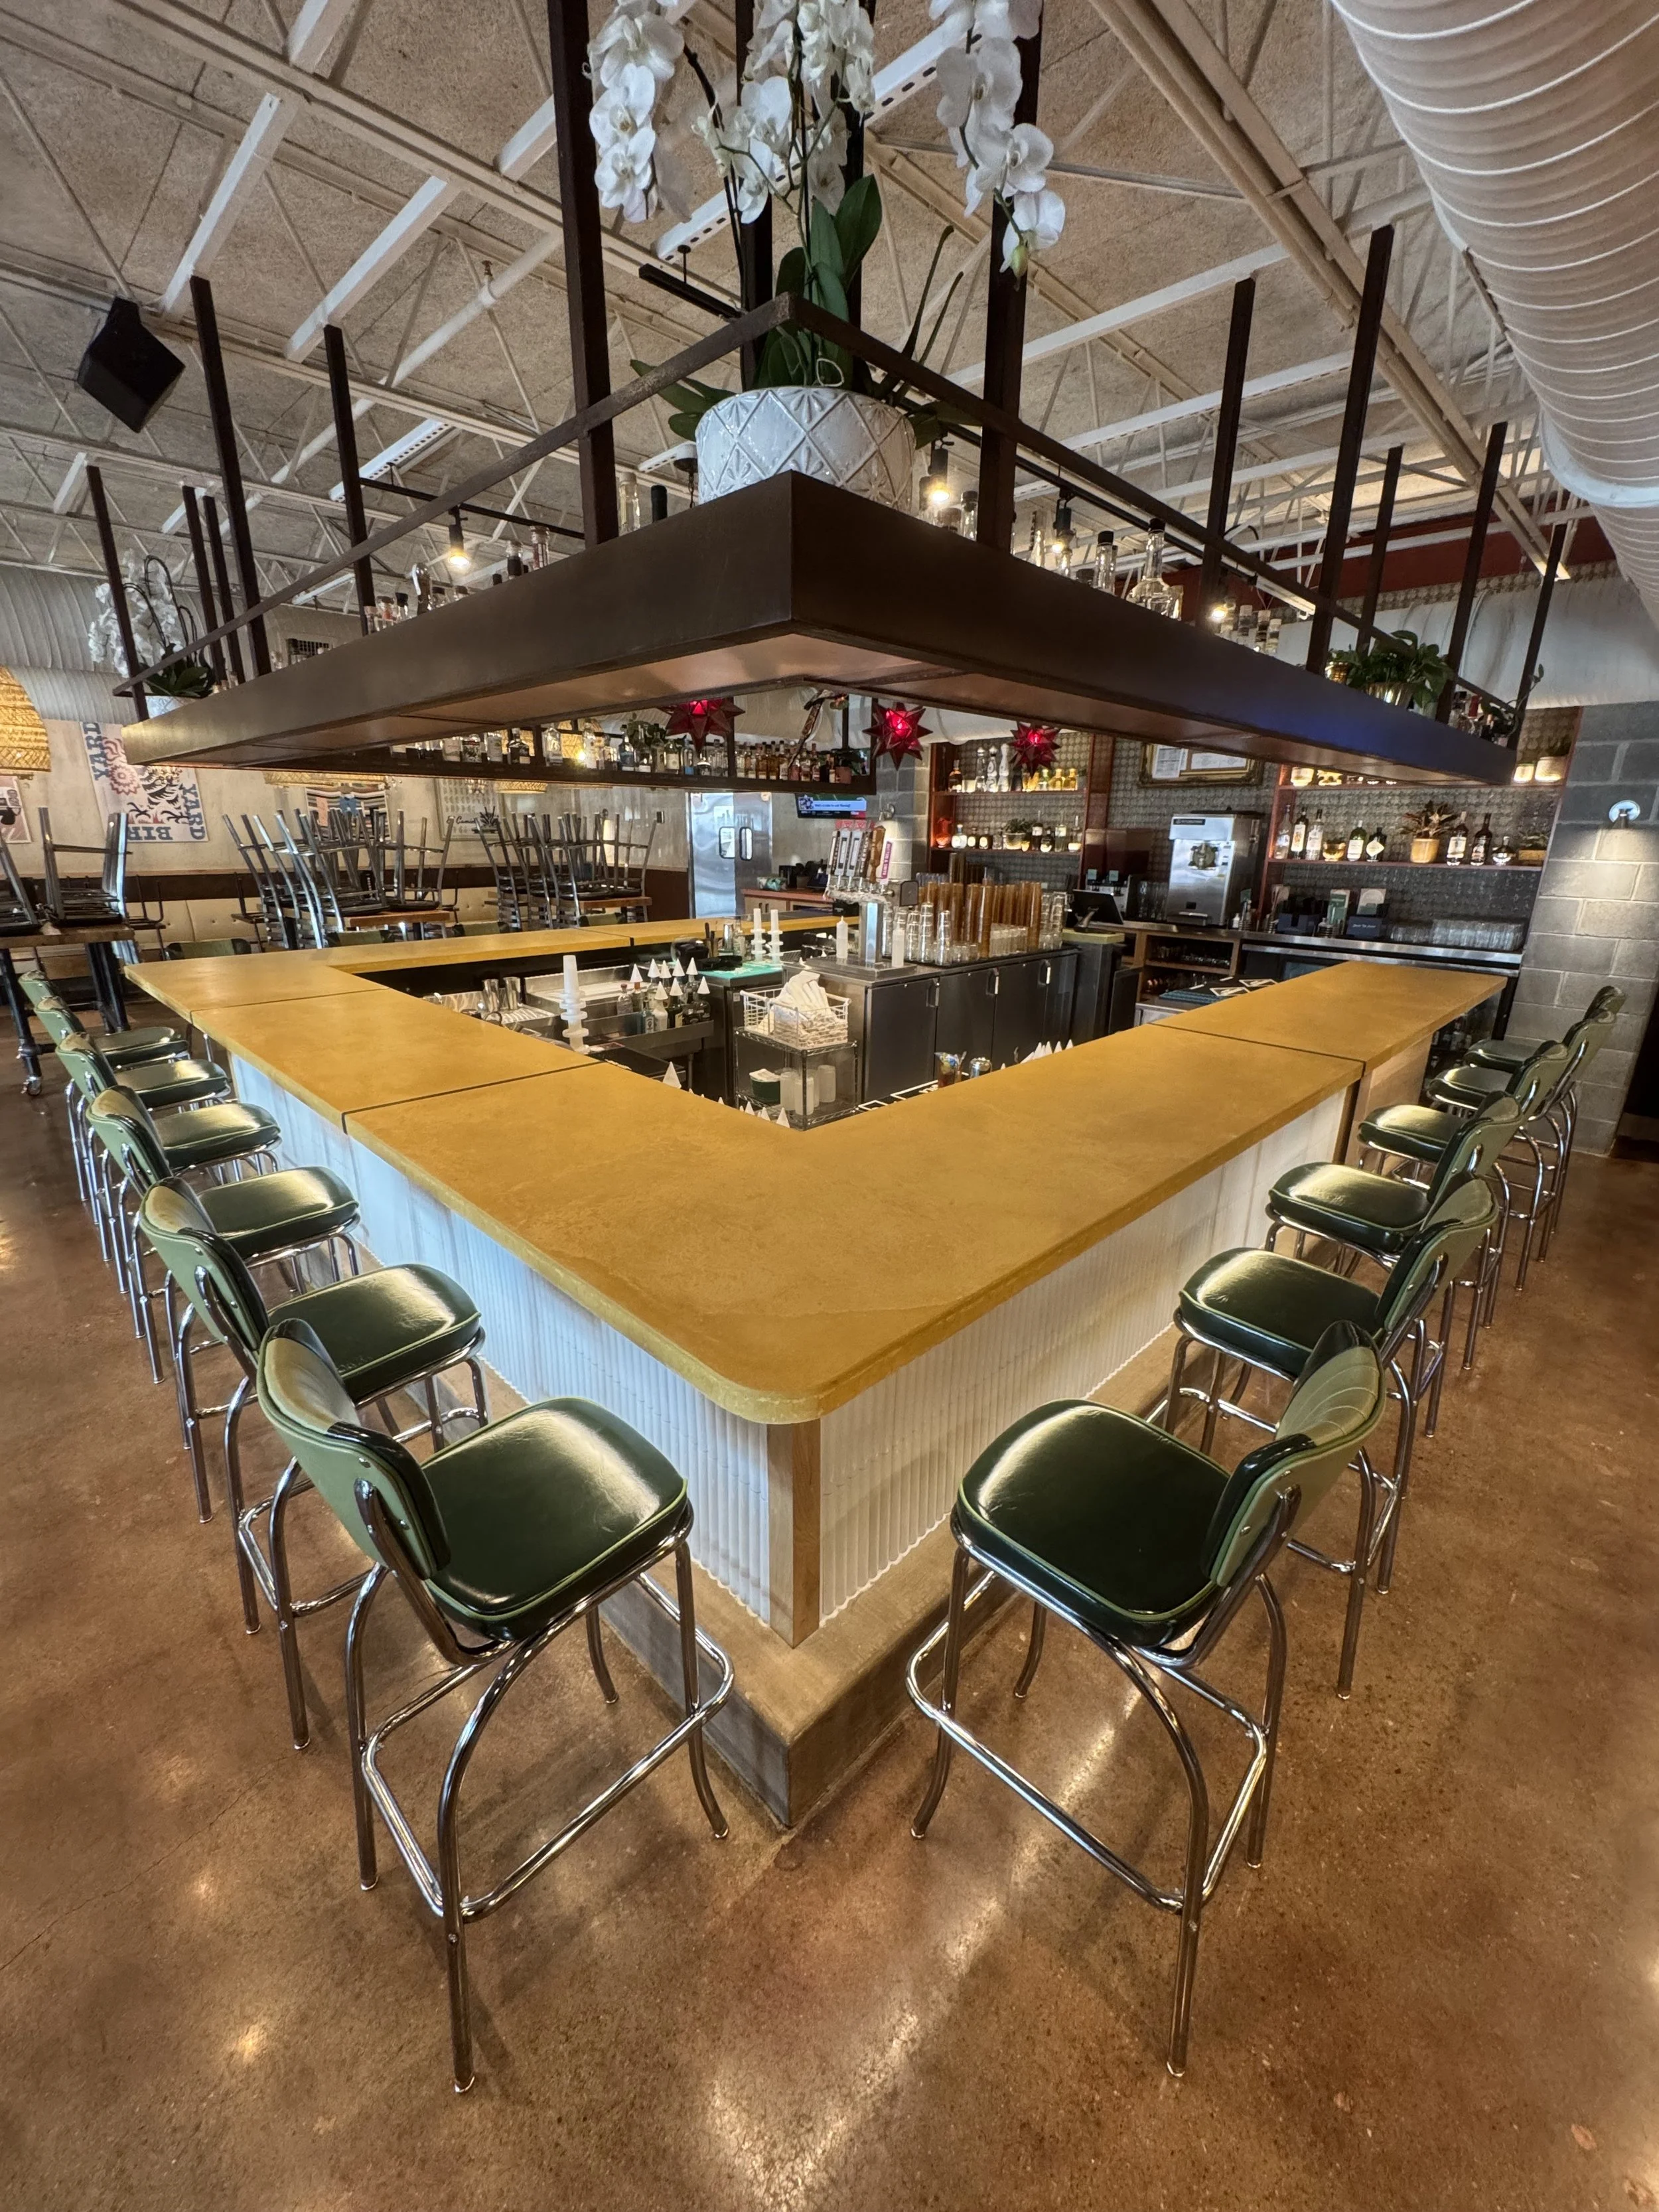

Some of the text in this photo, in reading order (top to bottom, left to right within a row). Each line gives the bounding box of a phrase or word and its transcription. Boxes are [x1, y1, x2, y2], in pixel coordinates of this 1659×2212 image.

[82, 721, 110, 781] YARD
[128, 826, 173, 840] BIR
[181, 783, 206, 840] YARD
